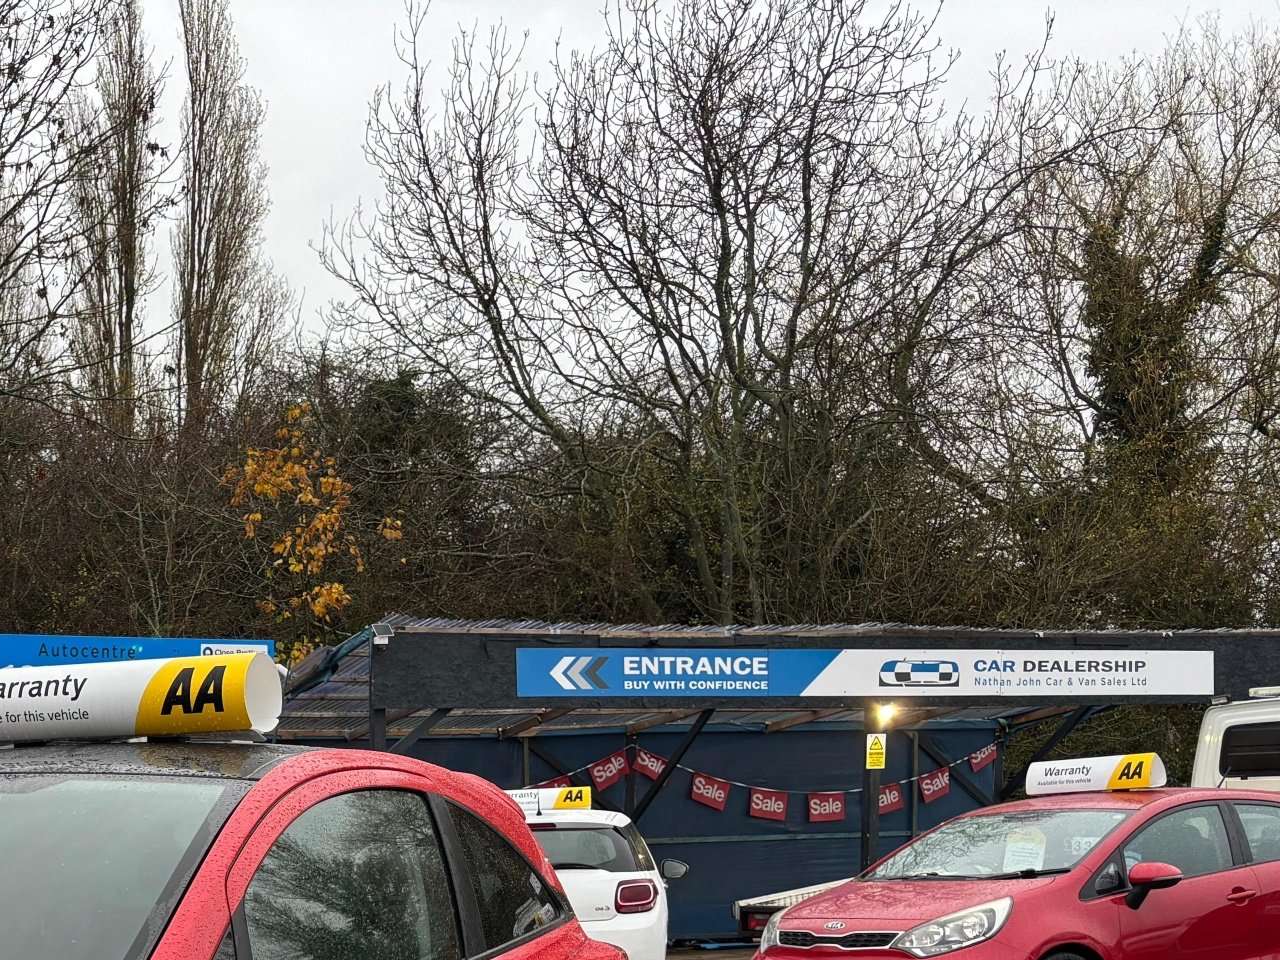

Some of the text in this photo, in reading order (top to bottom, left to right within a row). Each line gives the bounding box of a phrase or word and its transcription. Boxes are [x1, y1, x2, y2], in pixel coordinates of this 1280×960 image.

[38, 643, 136, 659] Autocentre
[623, 656, 768, 675] ENTRANCE
[973, 659, 1146, 673] CAR DEALERSHIP
[624, 680, 768, 690] BUY WITH CONFIDENCE
[974, 677, 1012, 686] Nathan
[1016, 677, 1041, 686] John
[1046, 677, 1063, 686] Car
[1078, 677, 1096, 686] Van
[1101, 677, 1127, 686] Sales
[1131, 677, 1147, 686] Ltd
[160, 665, 227, 716] AA
[5, 711, 21, 723] for
[24, 710, 46, 723] this
[47, 708, 89, 722] vehicle
[593, 756, 624, 782] Sale
[1044, 761, 1144, 780] Warranty AA
[693, 777, 725, 801] Sale
[922, 771, 949, 795] Sale
[563, 790, 583, 802] AA
[752, 794, 784, 813] Sale
[879, 790, 899, 806] ale
[810, 798, 841, 815] Sale
